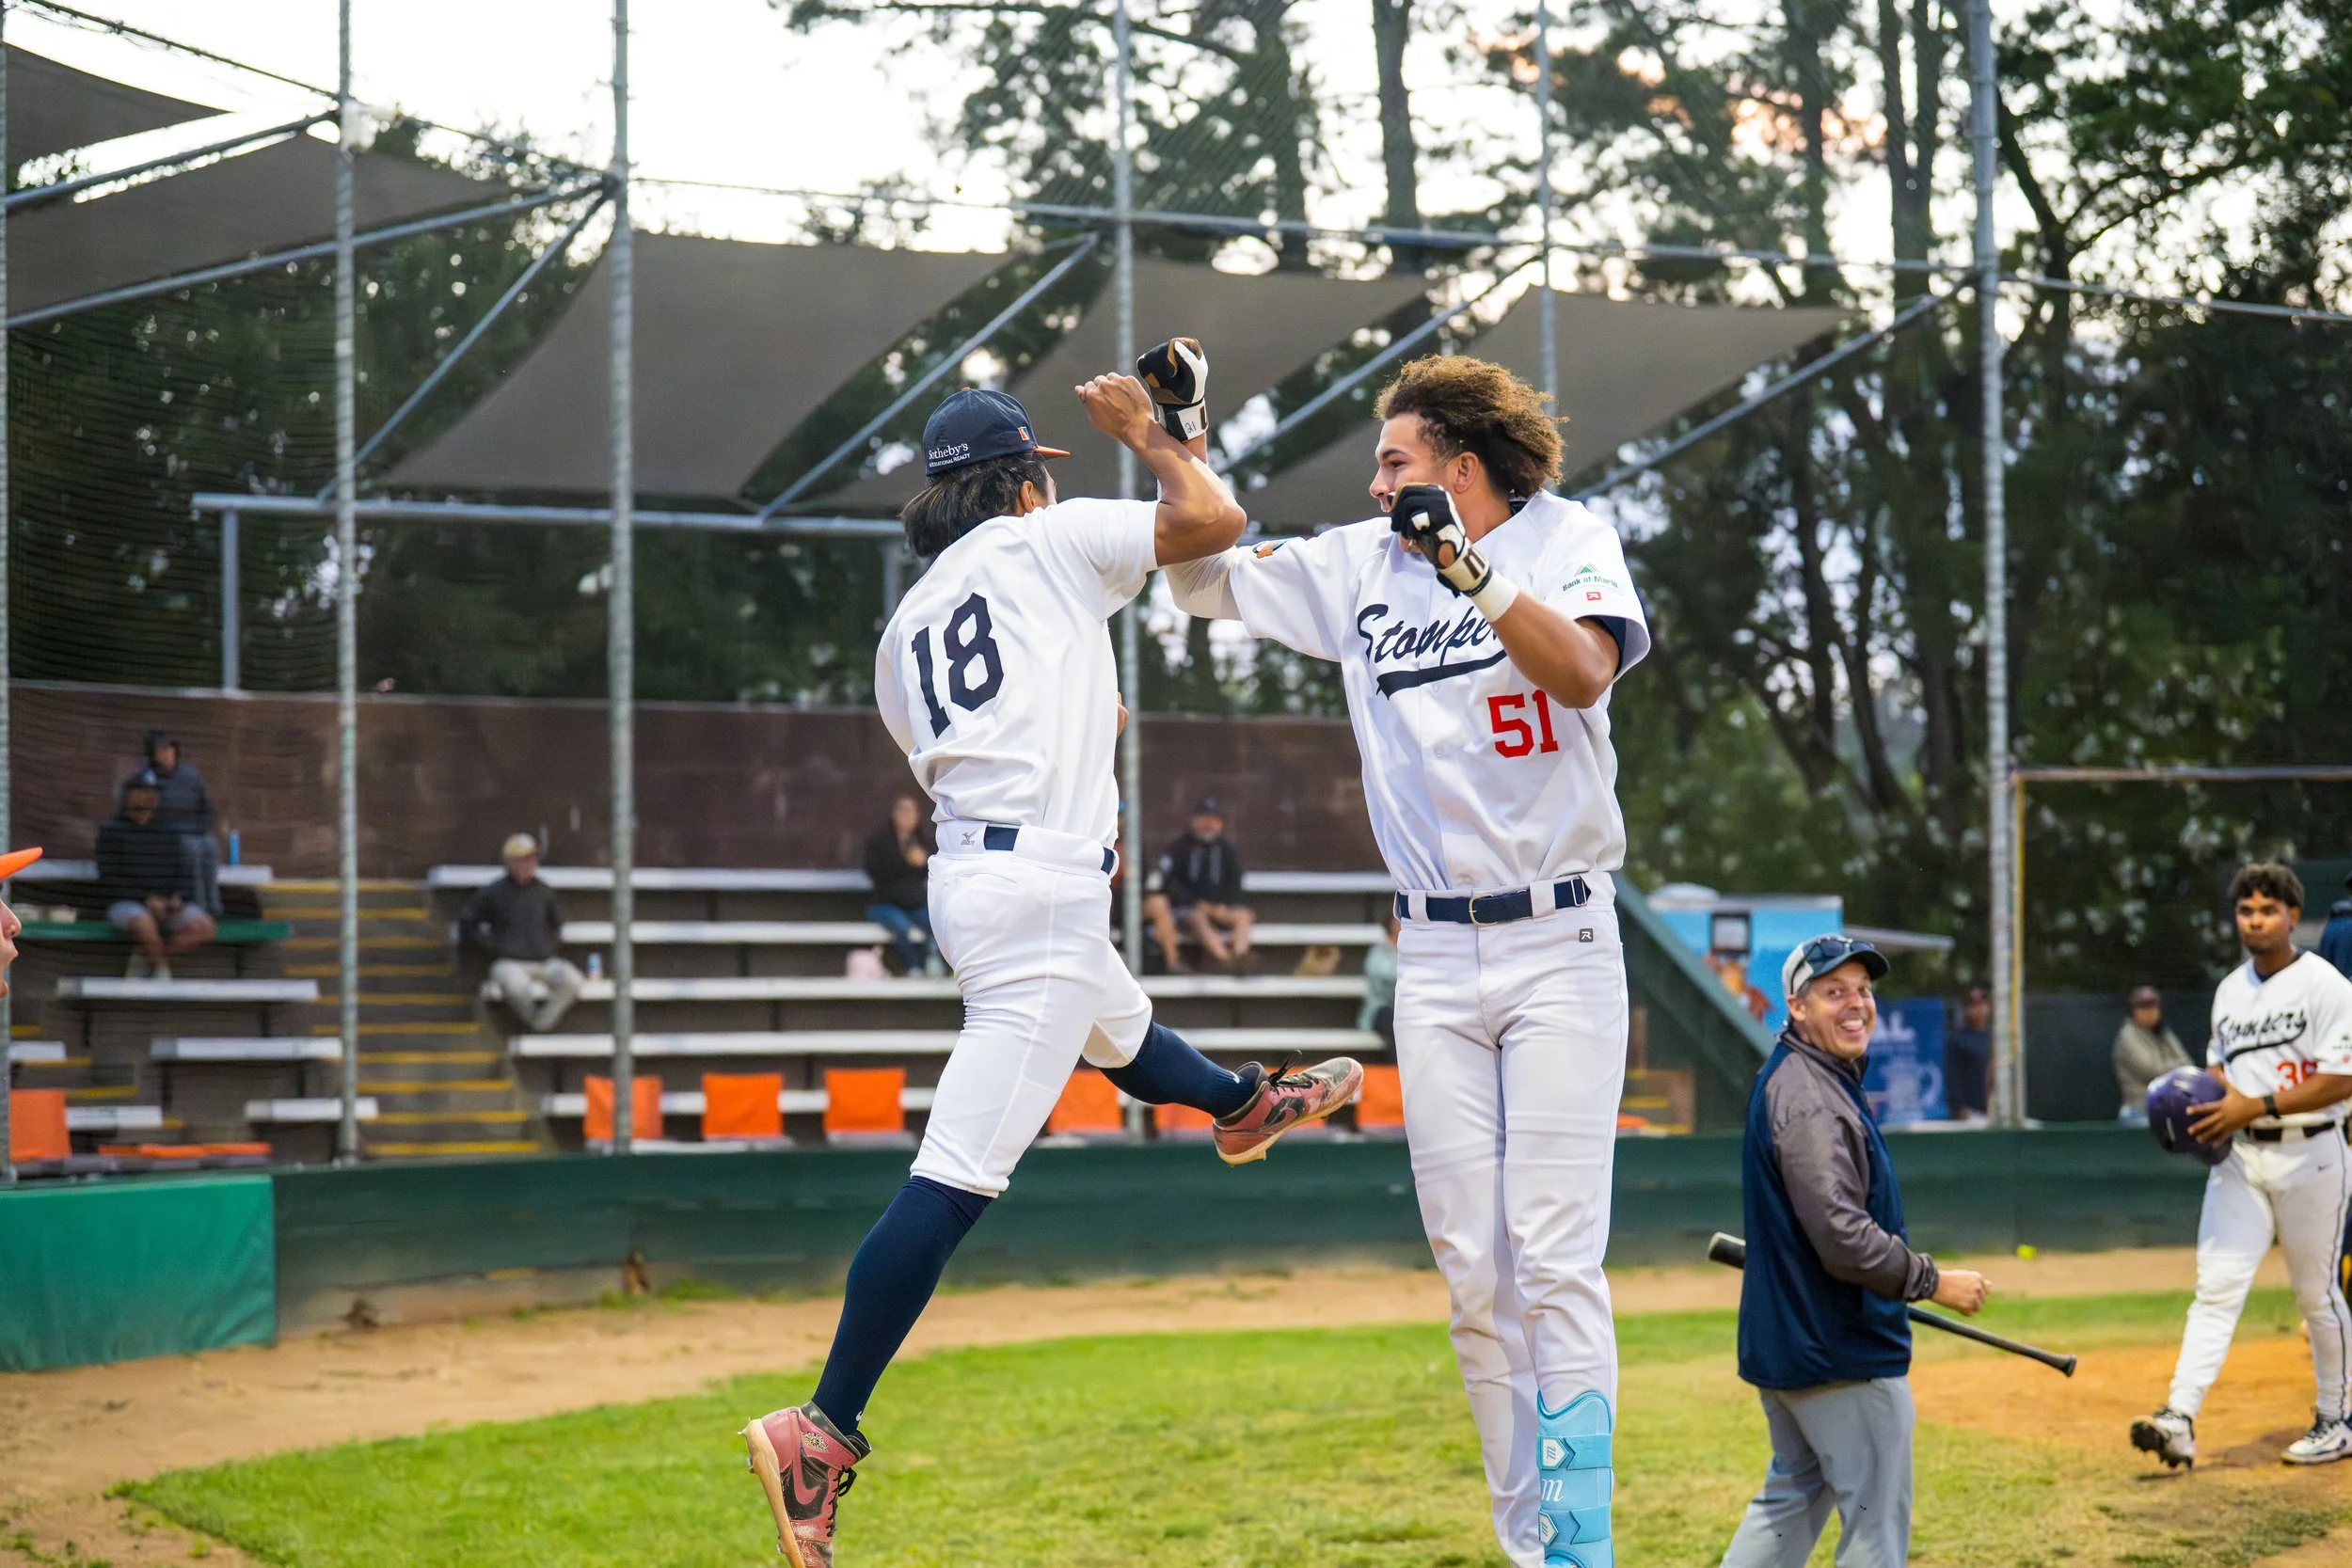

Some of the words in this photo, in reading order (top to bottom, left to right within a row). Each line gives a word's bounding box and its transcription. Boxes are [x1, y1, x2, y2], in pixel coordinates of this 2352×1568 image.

[1184, 421, 1197, 434] 21
[929, 443, 969, 460] Sotheby's
[953, 452, 971, 462] REALTY
[1562, 578, 1581, 592] Bank
[1357, 603, 1497, 668] Stompe
[911, 592, 1005, 740] 18
[1486, 689, 1559, 758] 51
